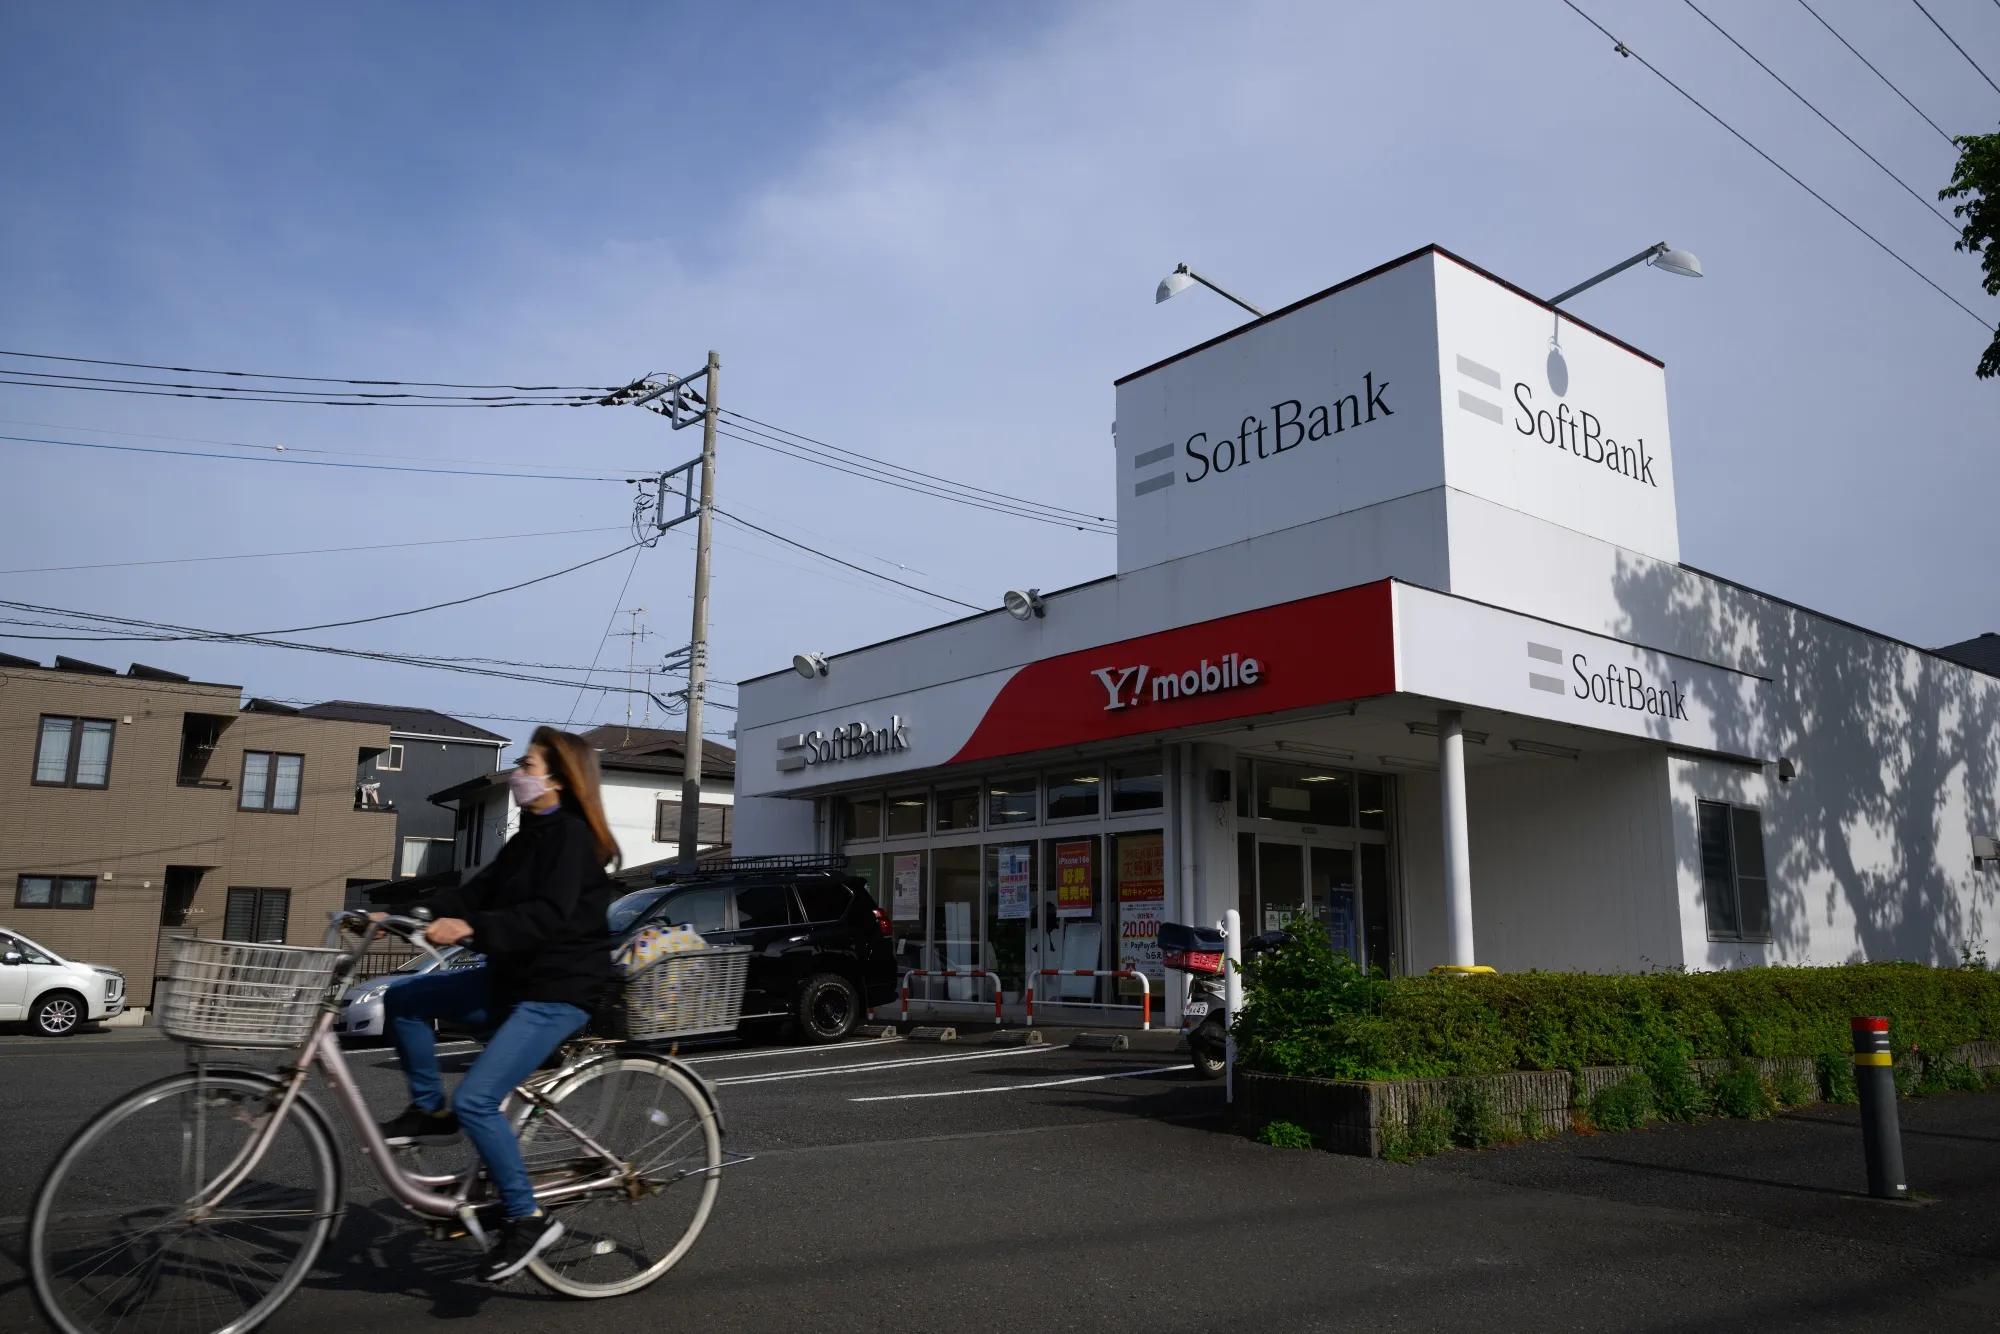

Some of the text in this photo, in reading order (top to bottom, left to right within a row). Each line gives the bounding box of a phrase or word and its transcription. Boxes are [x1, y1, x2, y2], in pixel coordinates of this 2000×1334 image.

[1185, 371, 1394, 483] SoftBank
[1514, 382, 1657, 487] SoftBank
[1572, 653, 1689, 722] SoftBank
[806, 715, 908, 767] SoftBank
[1058, 857, 1079, 865] iPhone
[1059, 885, 1089, 901] 発売中
